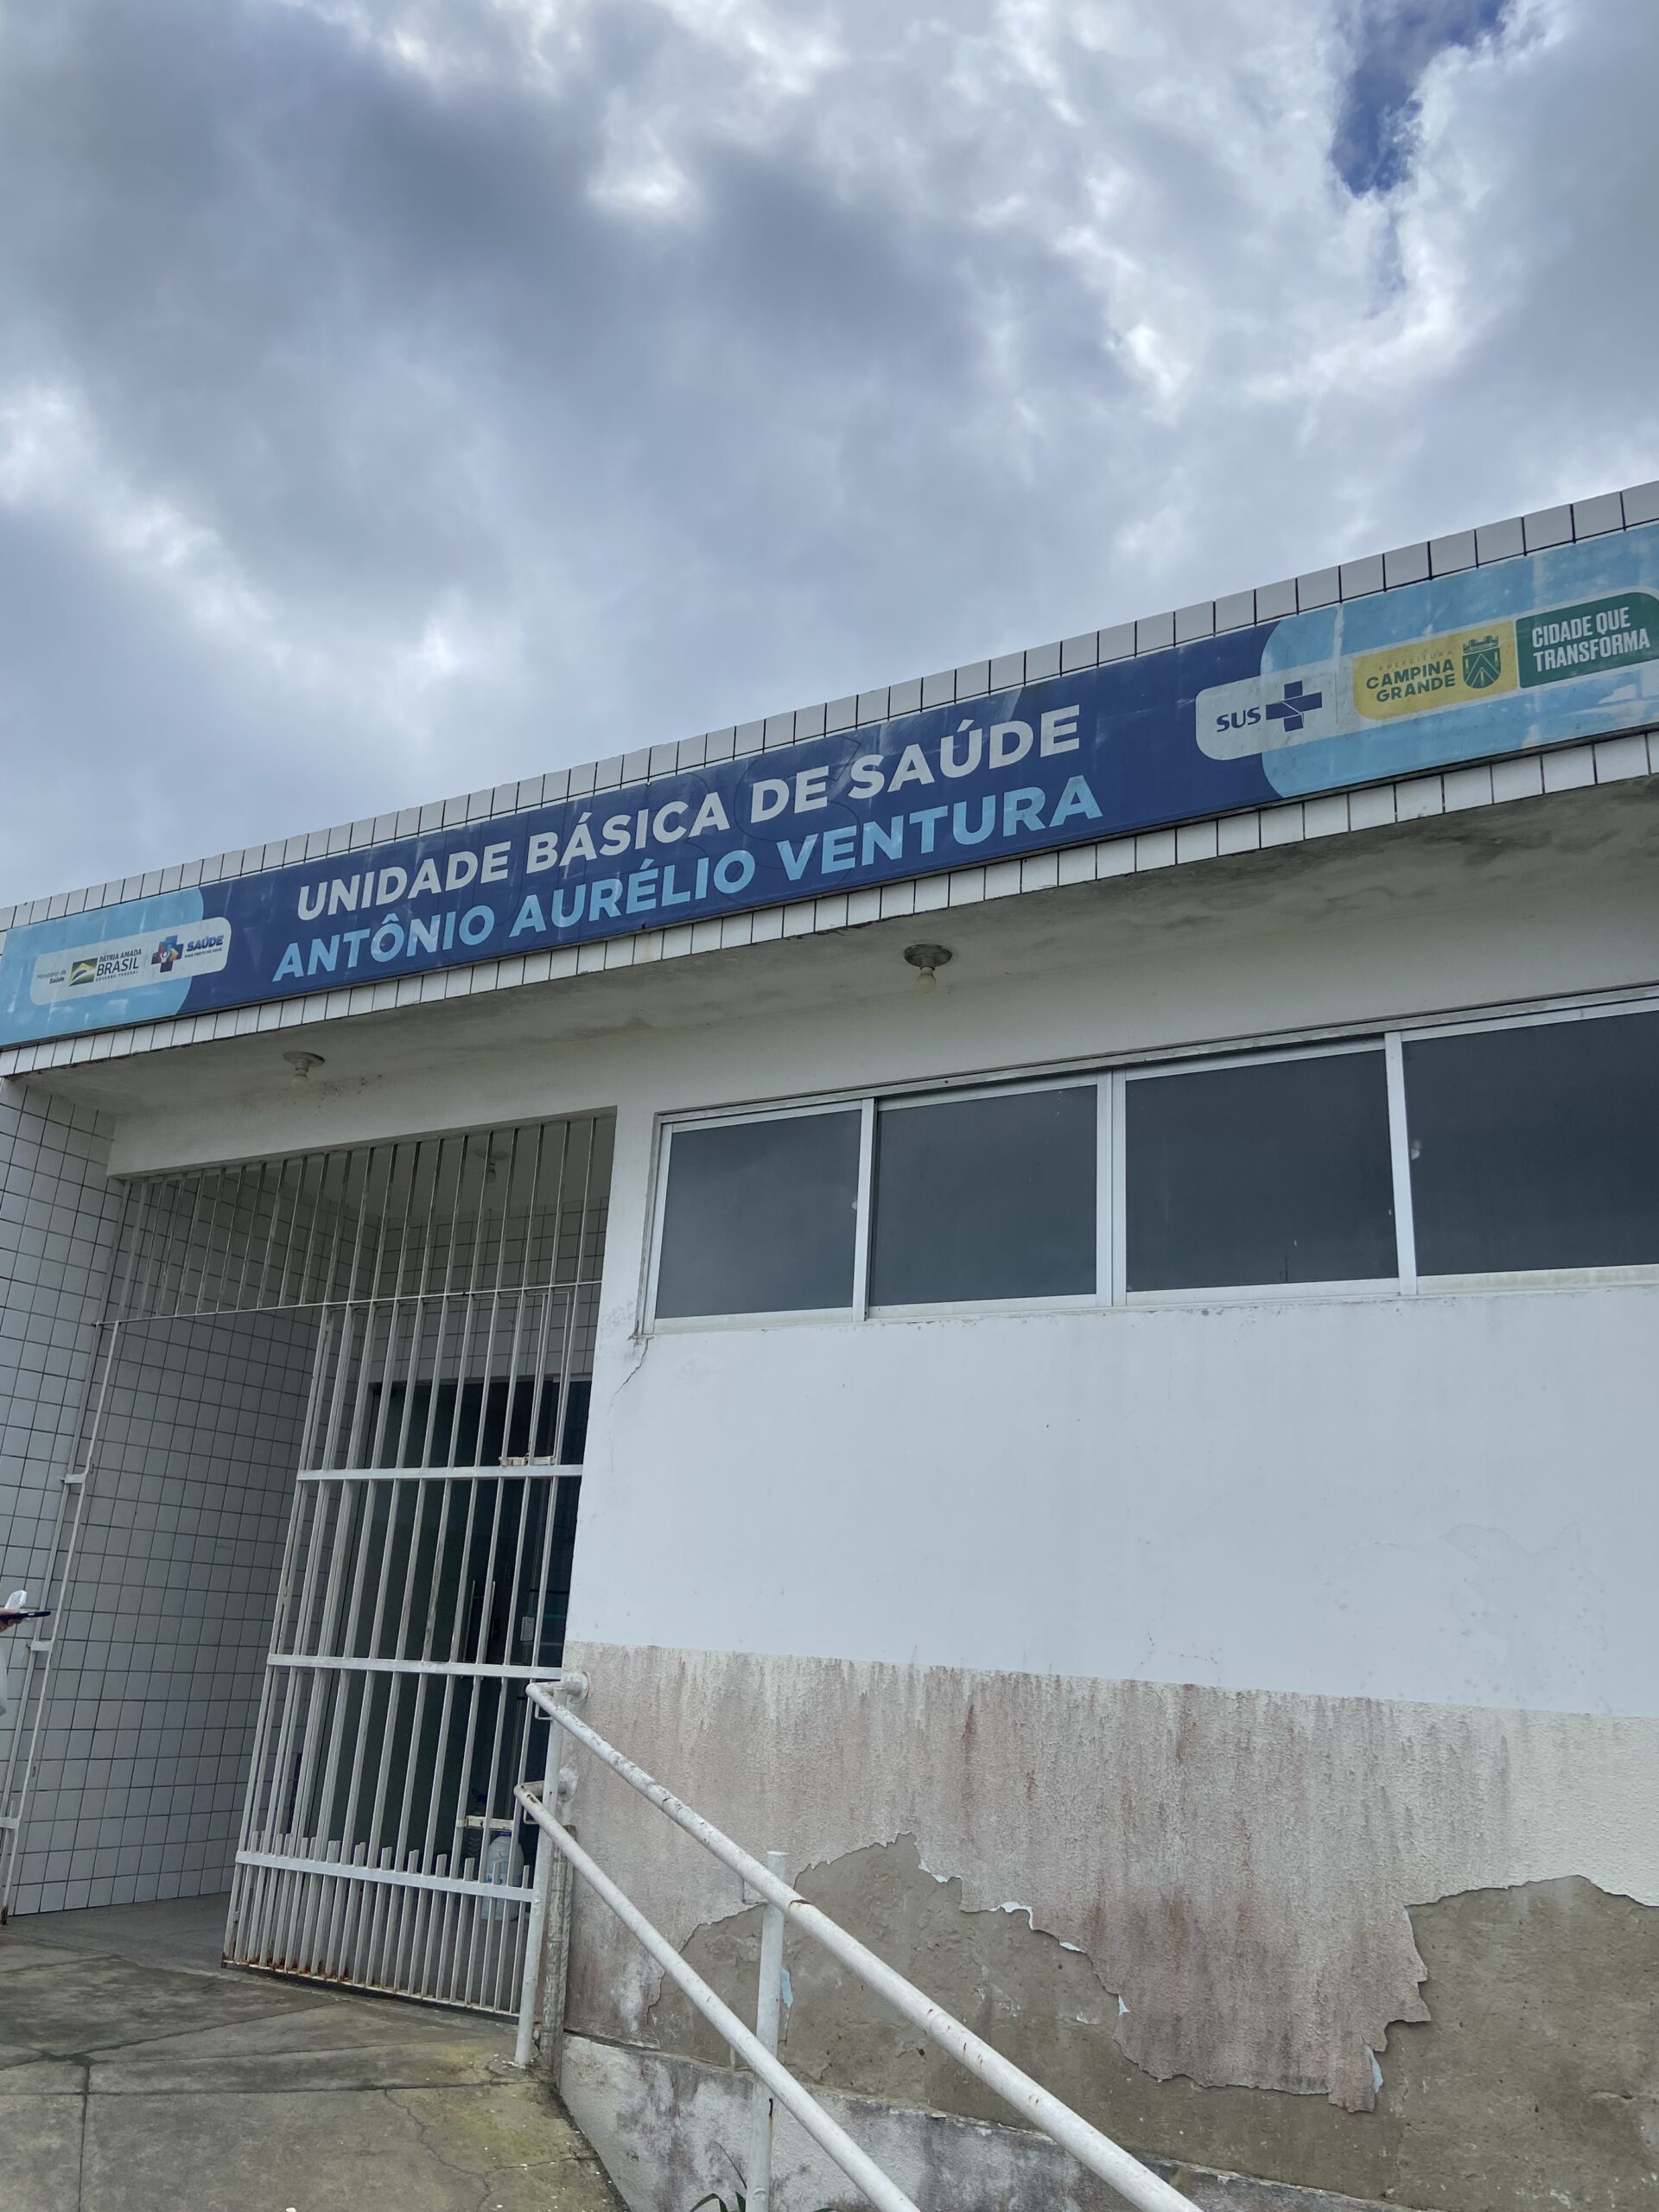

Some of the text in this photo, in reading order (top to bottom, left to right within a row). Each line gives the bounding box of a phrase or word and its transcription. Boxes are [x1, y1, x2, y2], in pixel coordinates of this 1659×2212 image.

[1532, 607, 1631, 648] CIDADE QUE
[1533, 628, 1650, 672] TRANSFORMA
[1366, 658, 1454, 690] CAMPINA
[1376, 674, 1456, 702] GRANDE
[1216, 707, 1262, 732] SUS
[297, 704, 1080, 921] UNIDADE BÁSICA DE SAÚDE
[272, 775, 1103, 982] ANTÔNIO AURÉLIO VENTURA
[120, 949, 142, 958] AMADA
[187, 934, 224, 951] SAÚDE
[97, 957, 139, 976] BRASIL
